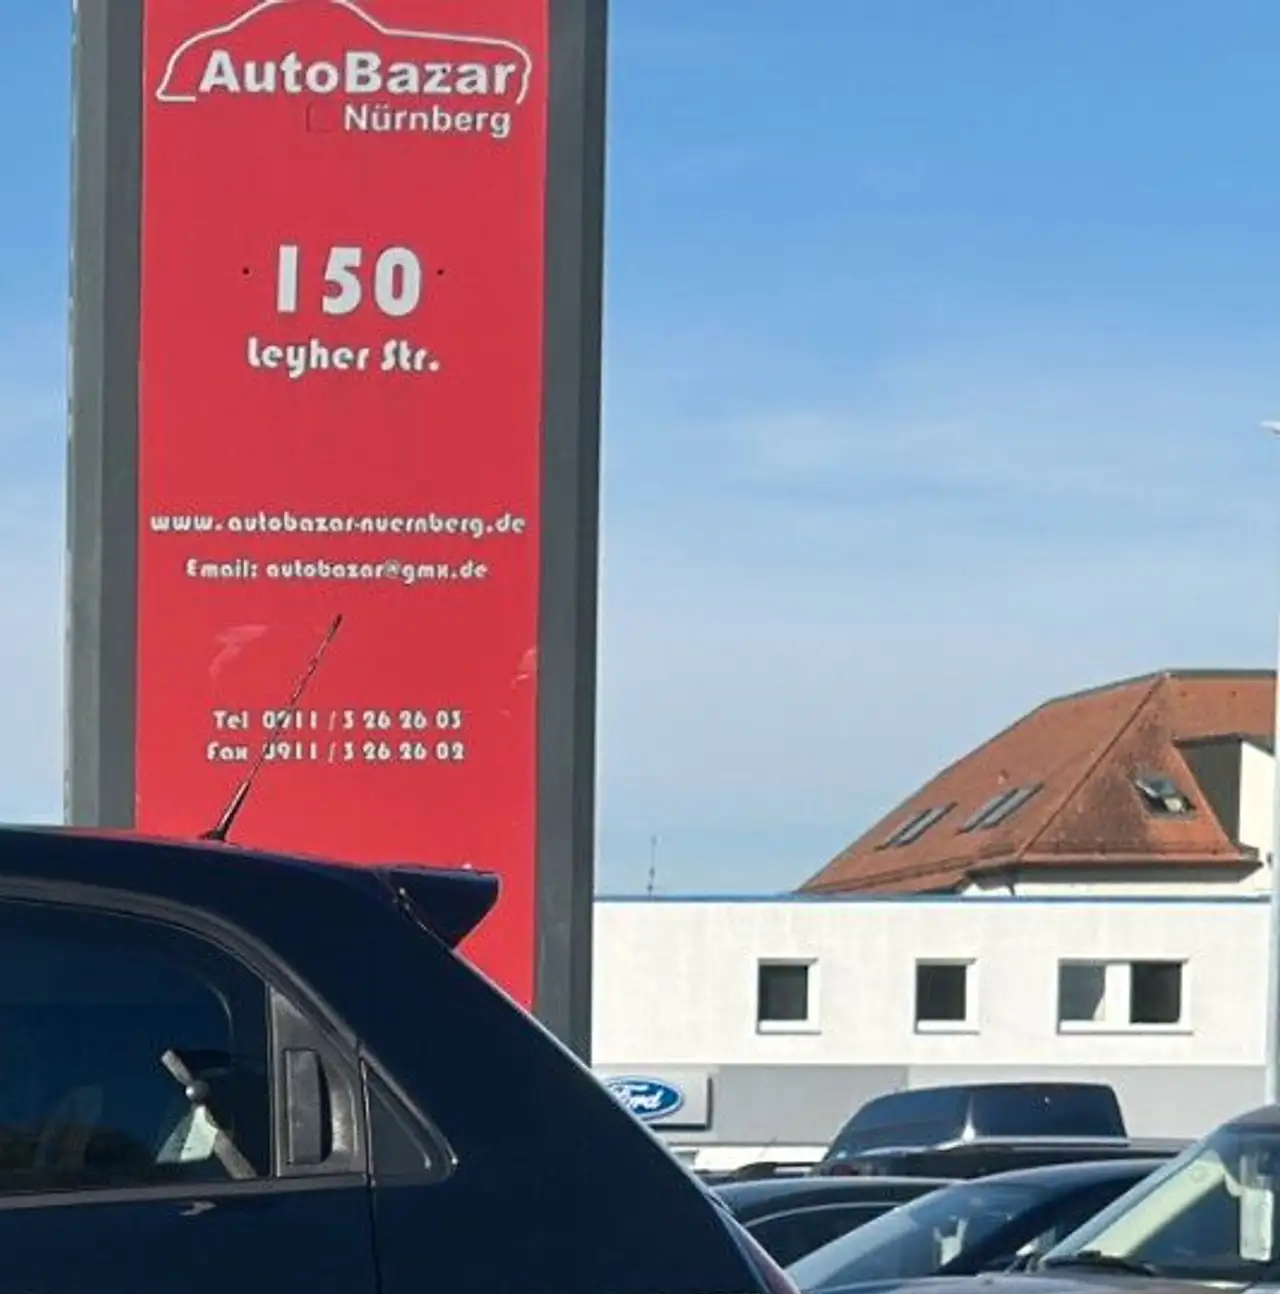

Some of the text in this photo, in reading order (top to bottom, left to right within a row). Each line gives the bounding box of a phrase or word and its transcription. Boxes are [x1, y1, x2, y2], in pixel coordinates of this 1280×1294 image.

[198, 49, 518, 95] AutoBazar
[344, 104, 512, 138] Nürnberg
[248, 337, 439, 378] Leyher Str.
[151, 511, 525, 538] www.autobazar-nuernberg.de
[186, 558, 488, 583] Email: autobazar@gmx.de
[213, 710, 248, 729] Tel
[262, 710, 317, 729] 0911
[206, 741, 248, 760] Fax
